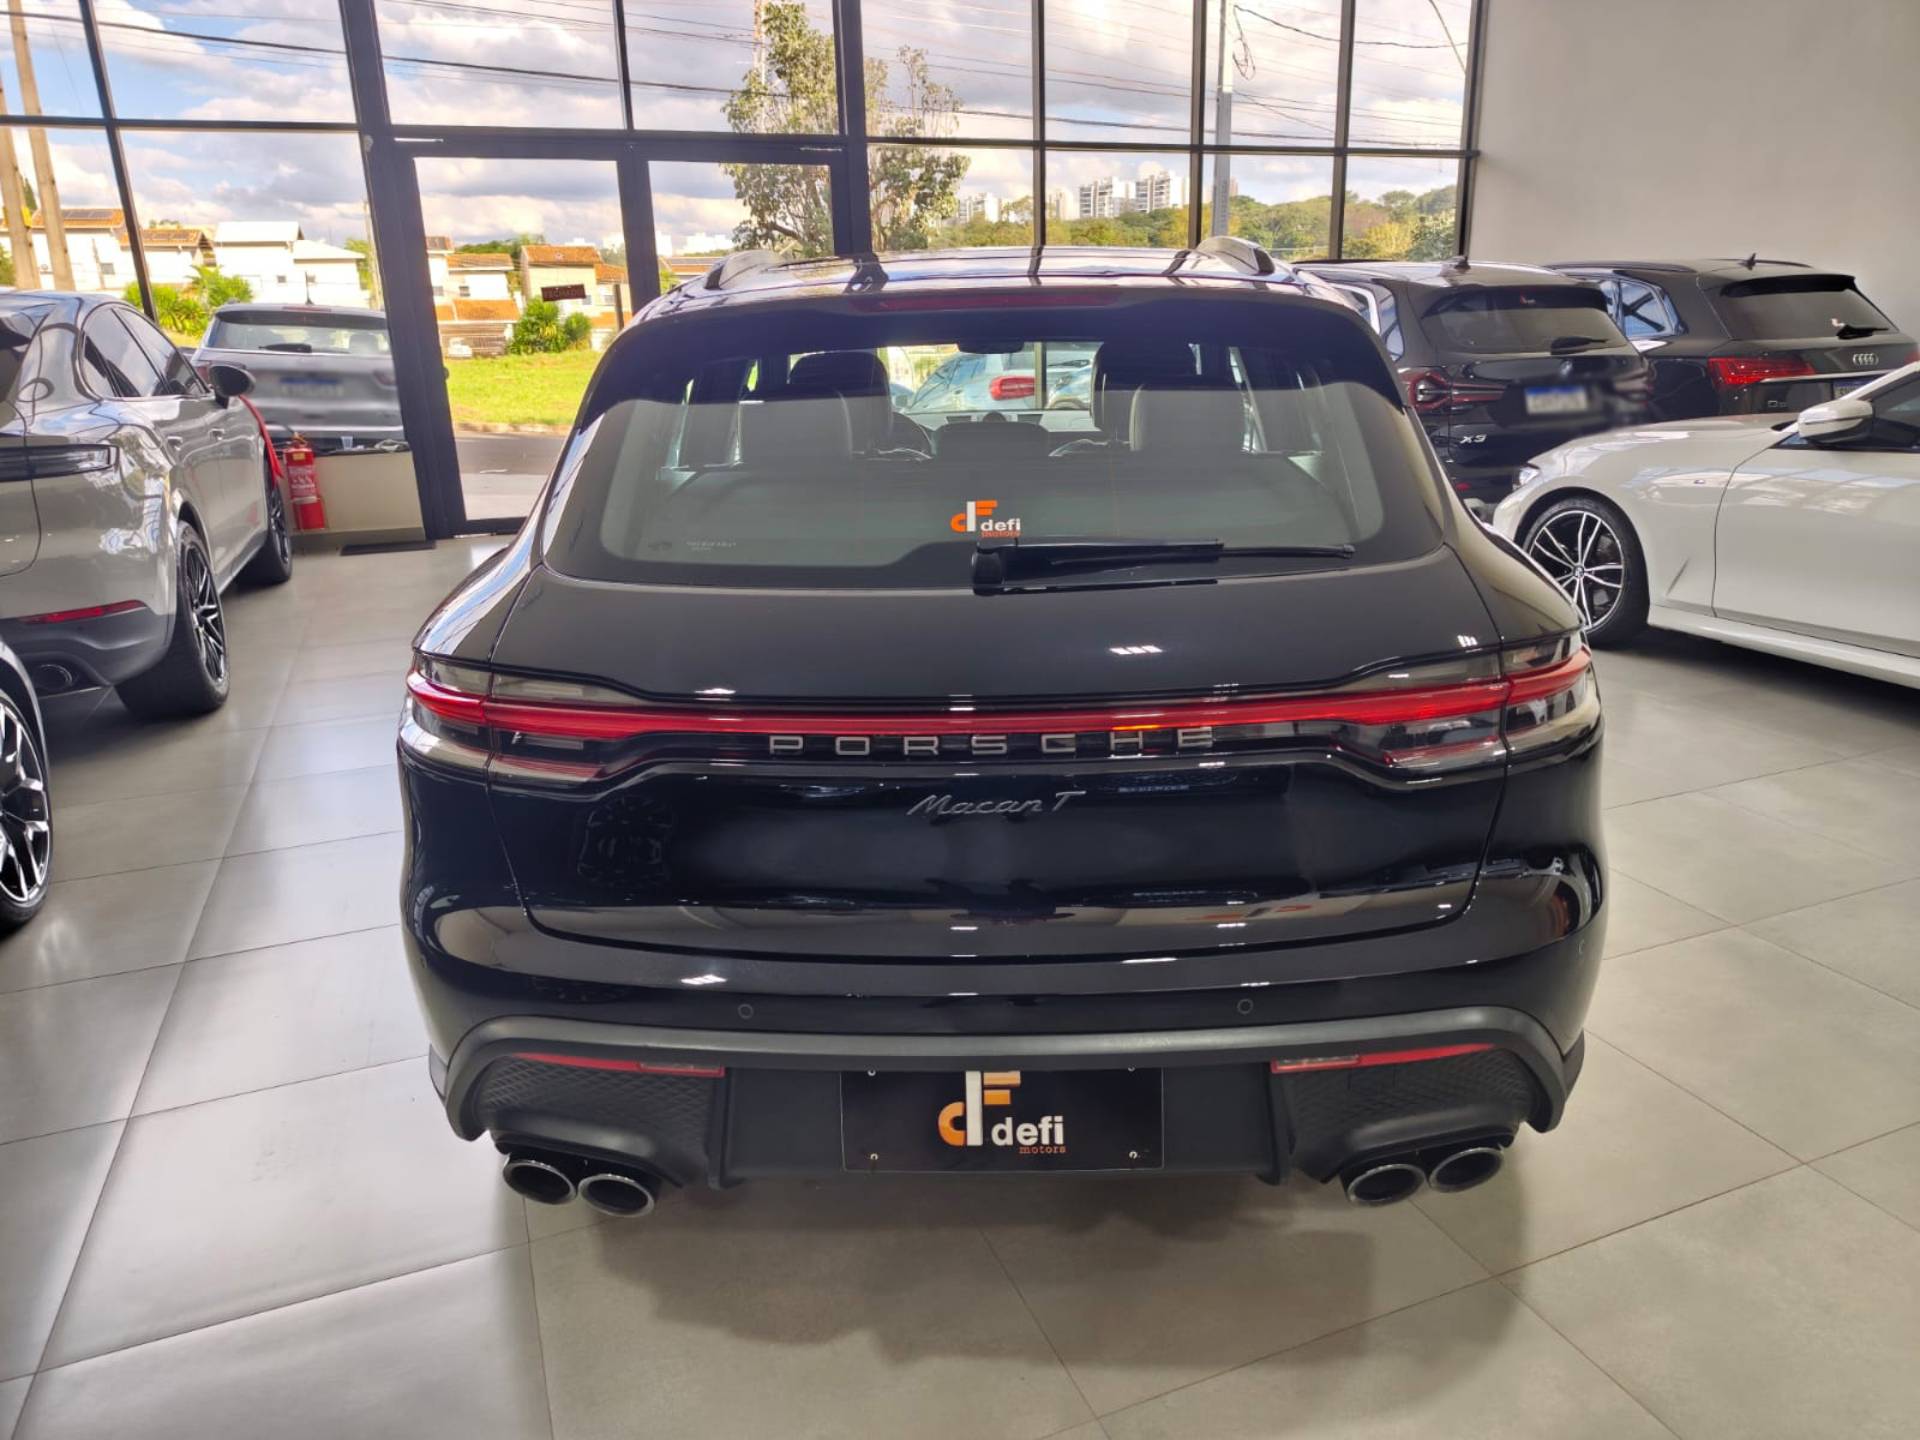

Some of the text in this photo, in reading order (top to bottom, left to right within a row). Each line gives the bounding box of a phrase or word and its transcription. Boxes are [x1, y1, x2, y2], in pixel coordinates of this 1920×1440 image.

[1459, 434, 1487, 444] X3
[980, 518, 1021, 531] defi
[769, 726, 1213, 757] PORSCHE
[907, 790, 1087, 816] Macan T
[991, 1115, 1064, 1146] defi
[1019, 1145, 1067, 1154] motors
